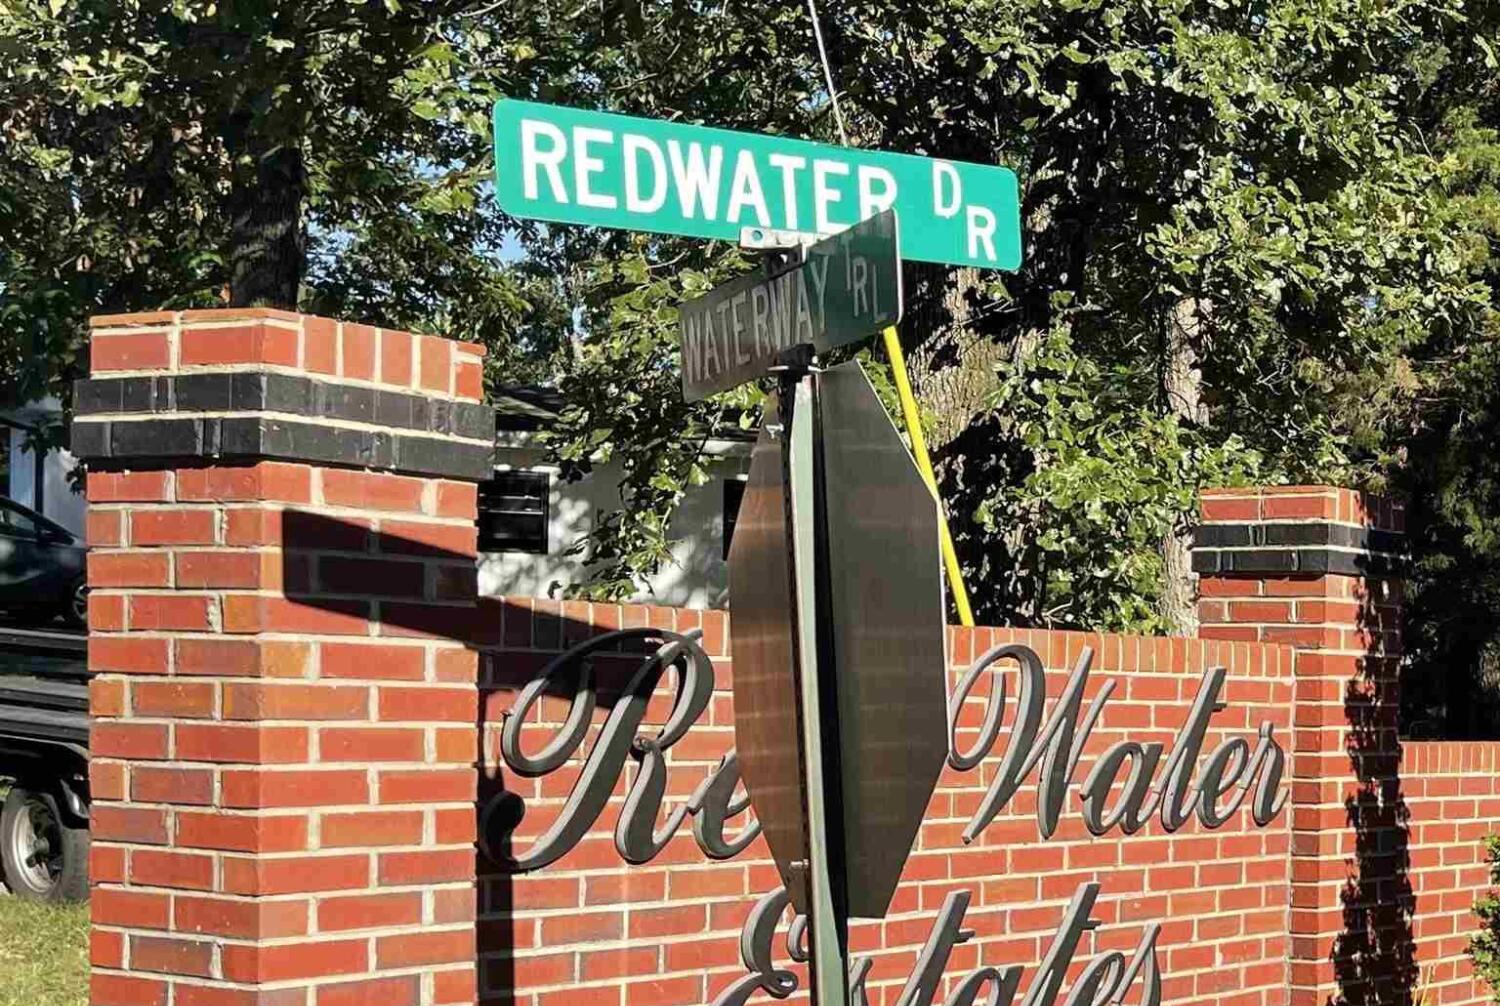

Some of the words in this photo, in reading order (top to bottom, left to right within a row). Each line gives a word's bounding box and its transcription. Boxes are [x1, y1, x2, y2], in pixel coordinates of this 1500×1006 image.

[520, 118, 898, 233] REDWATER
[932, 159, 998, 262] DR
[681, 253, 829, 384] WATERWAY
[478, 627, 763, 870] Re
[948, 643, 1290, 845] Water
